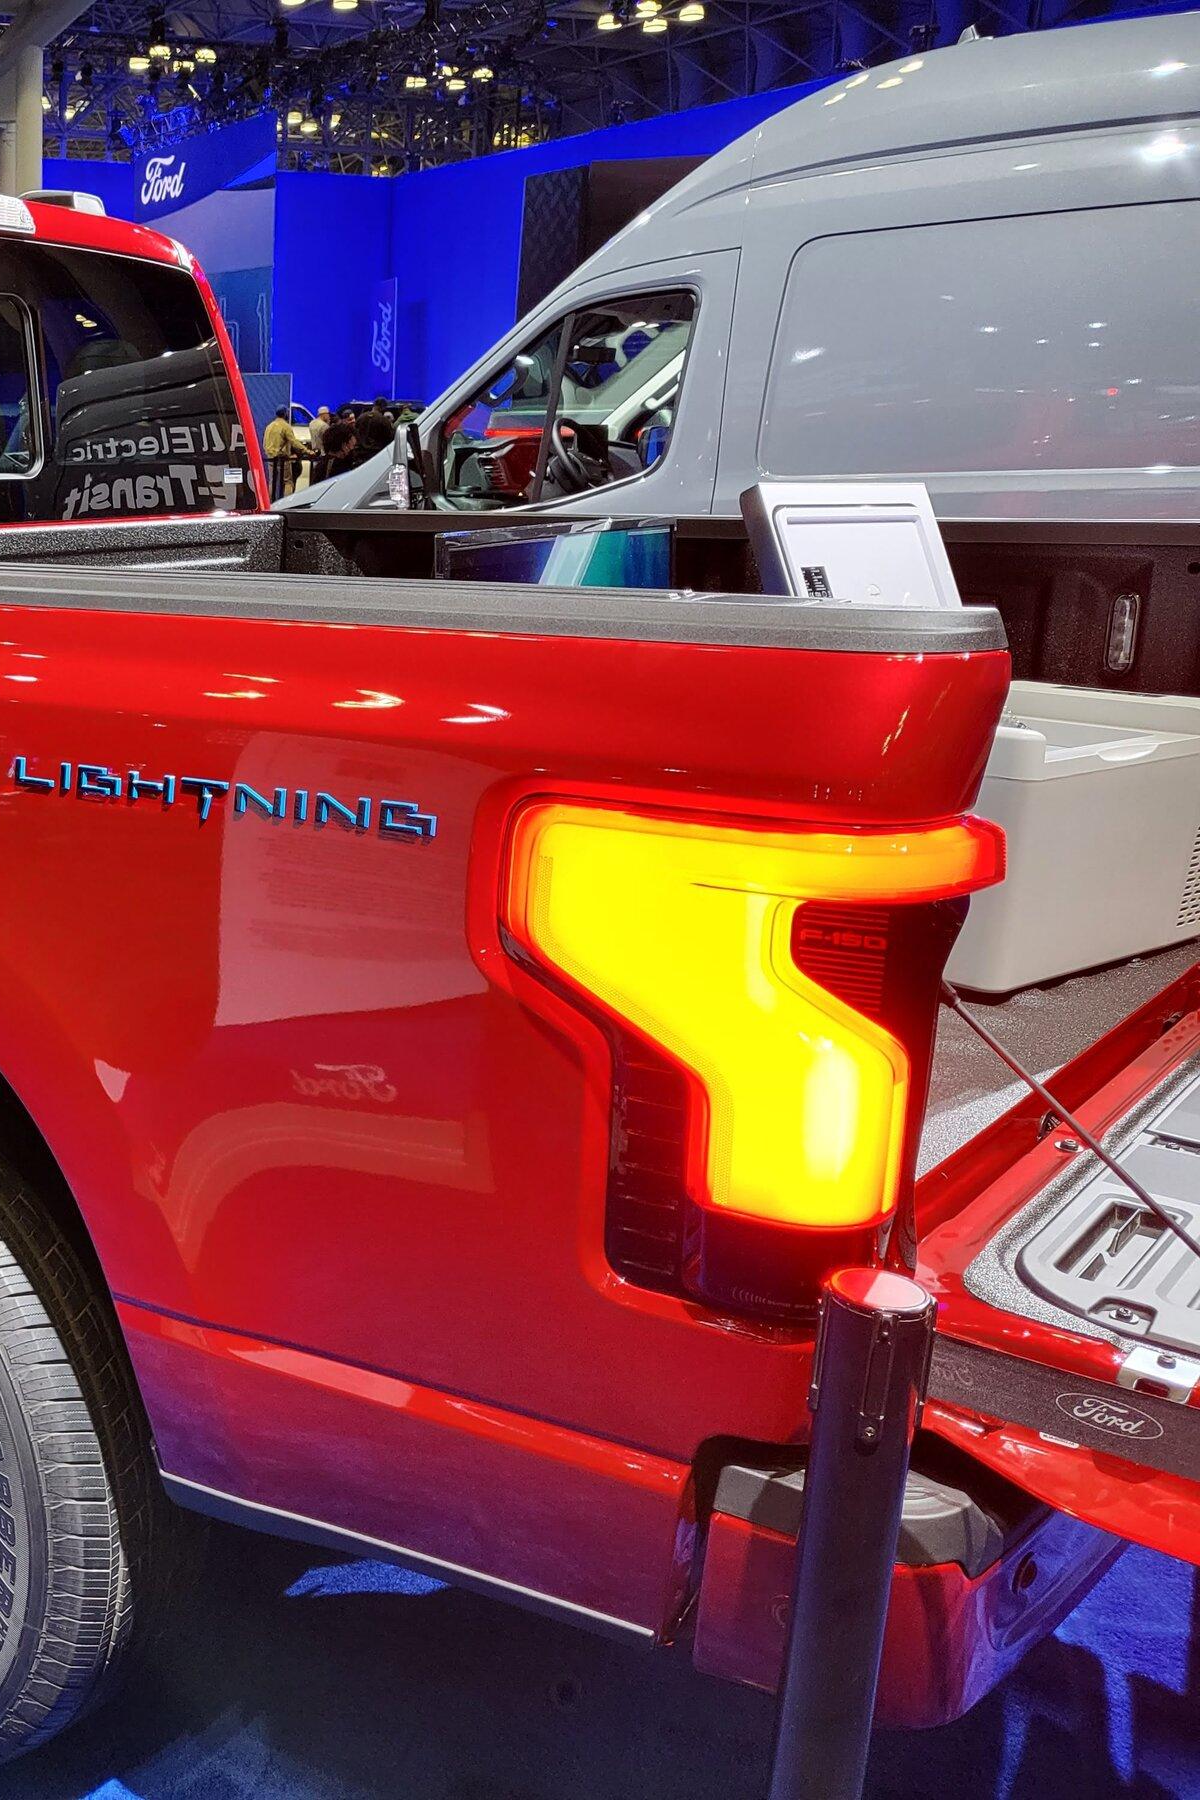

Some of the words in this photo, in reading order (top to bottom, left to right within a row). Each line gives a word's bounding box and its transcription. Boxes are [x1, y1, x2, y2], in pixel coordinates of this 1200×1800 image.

[141, 155, 186, 205] Ford
[372, 302, 392, 372] Ford
[14, 755, 438, 836] LIGHTNING
[800, 928, 887, 950] F-150
[1073, 1398, 1145, 1434] Ford
